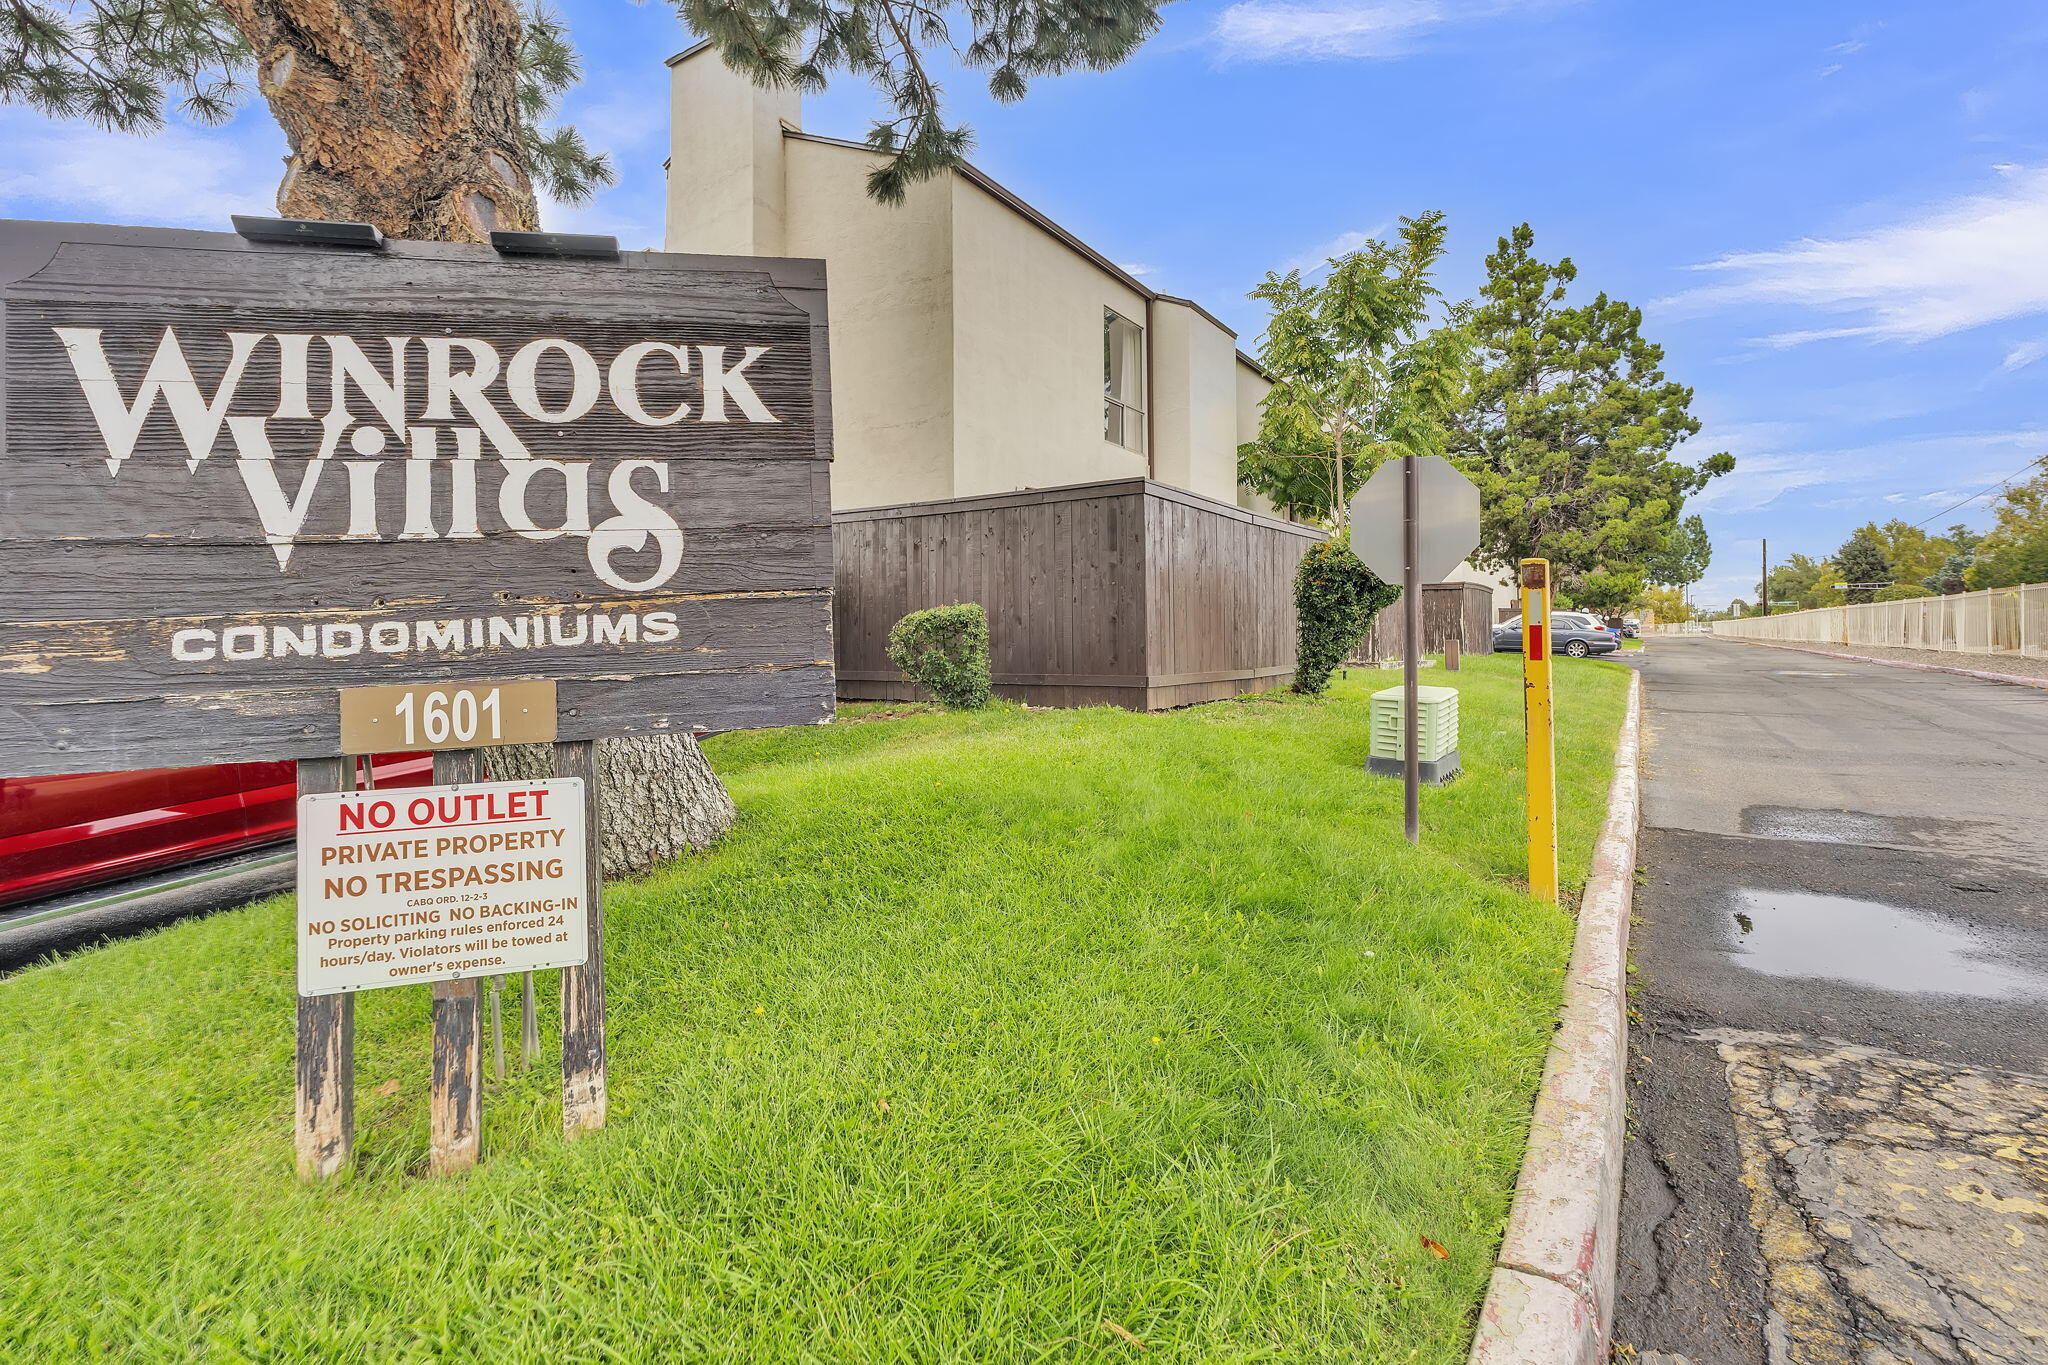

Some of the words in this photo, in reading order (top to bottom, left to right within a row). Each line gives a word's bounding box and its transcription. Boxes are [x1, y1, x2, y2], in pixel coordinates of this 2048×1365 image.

[52, 325, 782, 478] WINROCK
[226, 410, 684, 592] Villas
[171, 610, 680, 662] CONDOMINIUMS
[395, 688, 501, 744] 1601
[339, 801, 396, 831] NO
[408, 790, 549, 825] OUTLET
[321, 839, 428, 866] PRIVATE
[436, 828, 565, 856] PROPERTY
[324, 875, 368, 899] NO
[376, 858, 563, 894] TRESPASSING
[308, 921, 336, 936] NO
[340, 910, 441, 933] SOLICITING
[450, 907, 475, 921] NO
[480, 897, 578, 918] BACKING-IN
[407, 897, 434, 907] CABQ
[436, 895, 459, 904] ORD.
[460, 892, 488, 902] 12-2-3
[320, 950, 396, 968] hours/day.
[400, 944, 461, 959] Violators
[465, 939, 488, 952] will
[492, 938, 509, 949] be
[512, 933, 552, 947] towed
[555, 931, 568, 942] at
[328, 933, 391, 949] Property
[394, 927, 447, 944] parking
[450, 924, 483, 937] rules
[486, 917, 545, 933] enforced
[548, 915, 564, 926] 24
[389, 961, 443, 977] owner's
[446, 956, 506, 971] expense.
